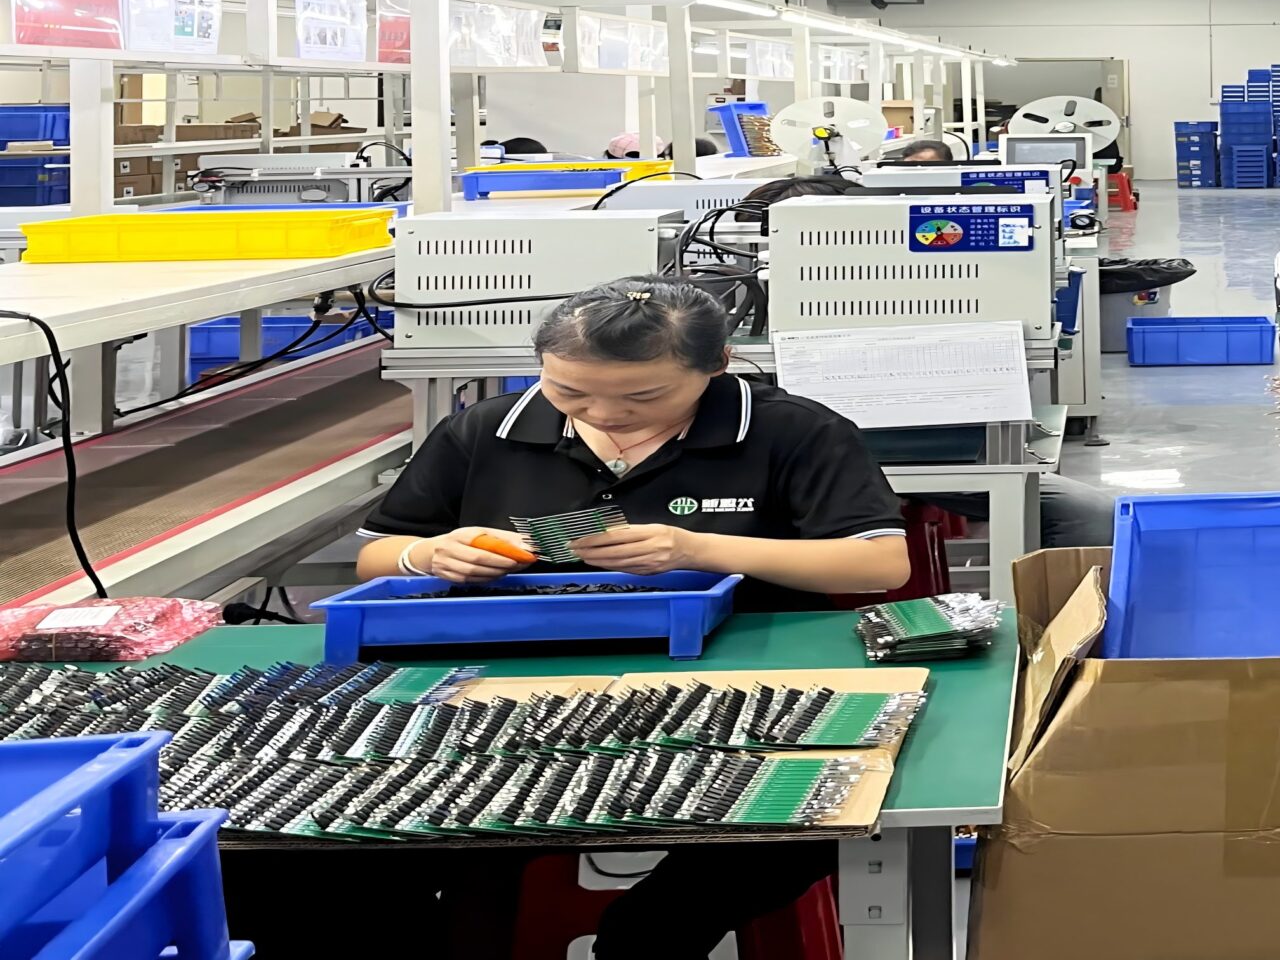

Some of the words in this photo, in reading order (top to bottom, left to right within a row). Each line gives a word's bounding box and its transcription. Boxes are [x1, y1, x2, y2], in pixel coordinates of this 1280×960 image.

[920, 205, 1021, 214] 设备状态管理标识
